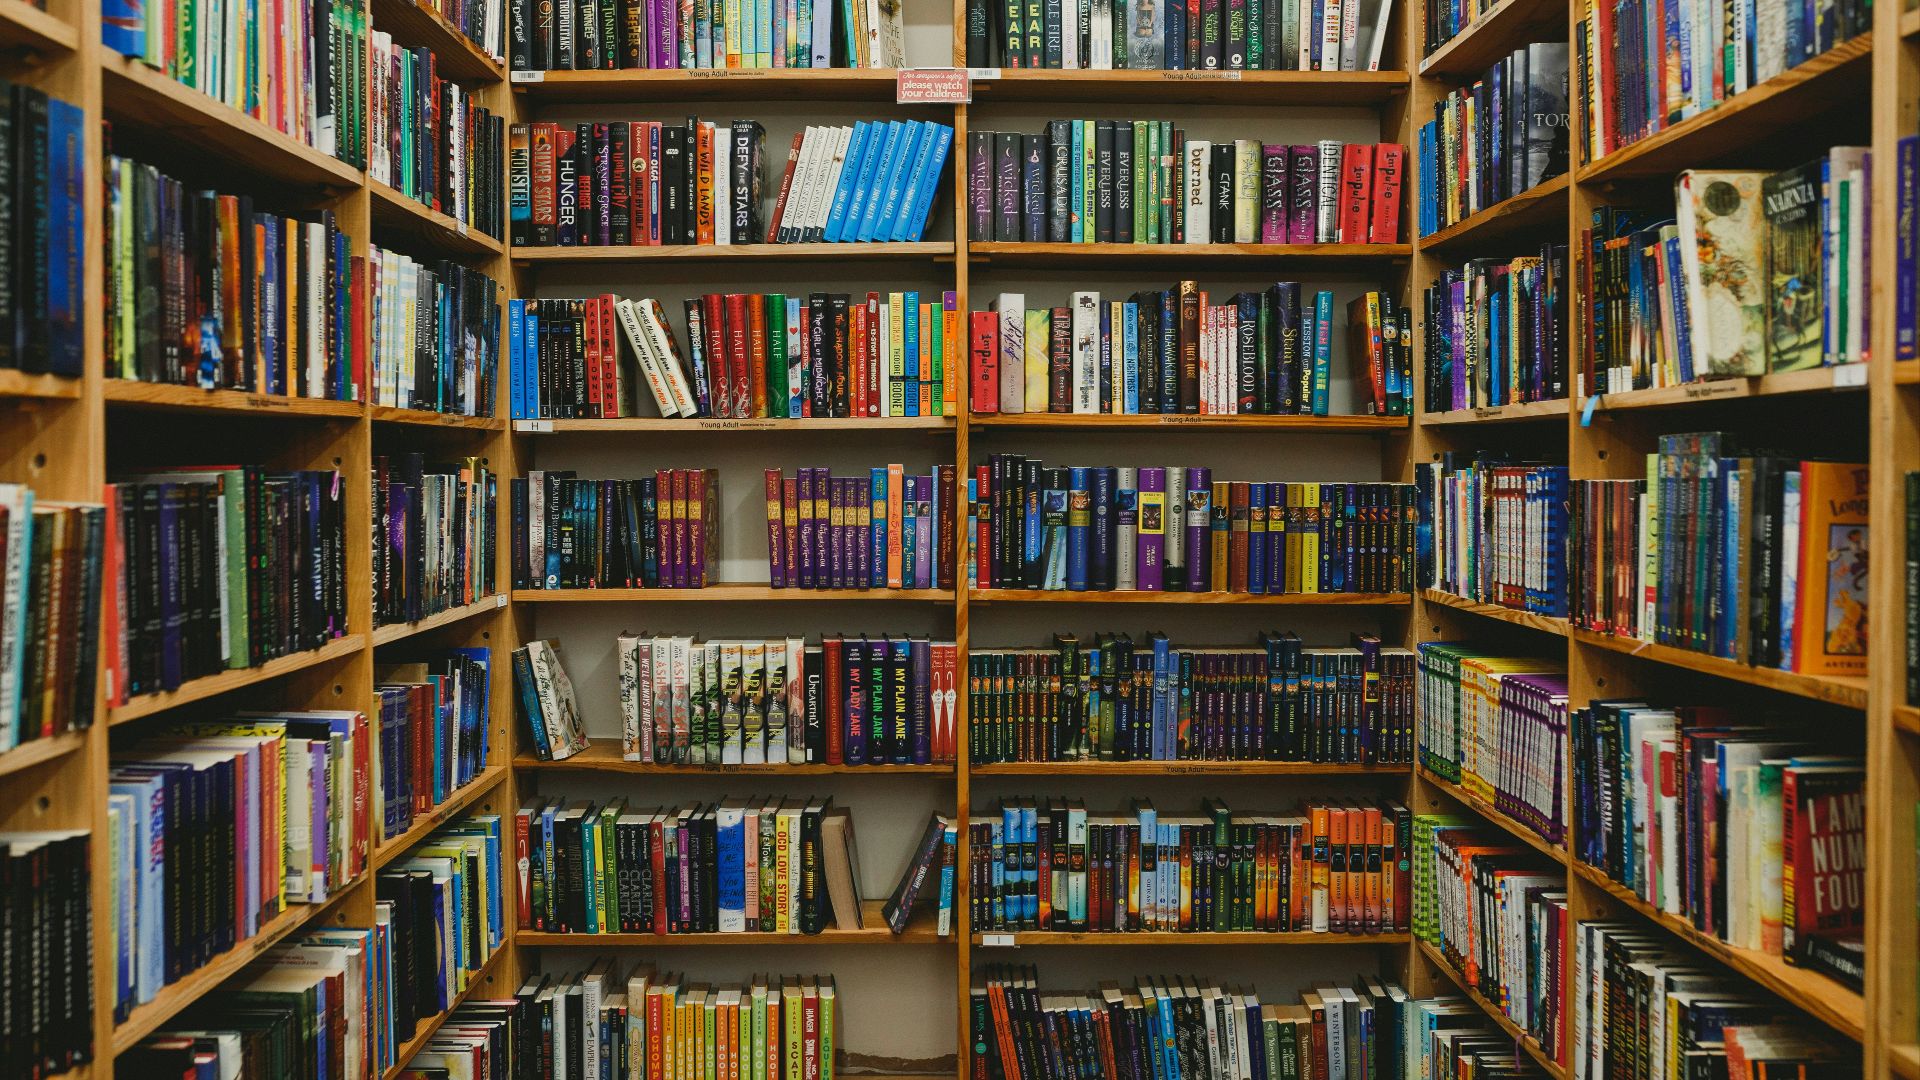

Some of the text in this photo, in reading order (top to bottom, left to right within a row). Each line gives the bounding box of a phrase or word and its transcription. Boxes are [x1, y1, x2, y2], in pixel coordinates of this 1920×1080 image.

[627, 7, 641, 46] DEEPER
[977, 8, 986, 37] GREAT
[1047, 24, 1060, 55] FIRE
[901, 89, 965, 99] your children.
[903, 80, 963, 90] please watch
[1162, 72, 1183, 80] Young
[512, 127, 526, 135] GRANT
[1533, 113, 1569, 129] TOR
[511, 149, 529, 209] MONSTER
[534, 143, 551, 222] SILVER STARS
[597, 145, 609, 227] STRANGE GRACE
[650, 159, 658, 181] OLGA
[700, 152, 709, 184] WILD
[736, 137, 748, 227] DEFY STARS
[976, 160, 991, 213] wicked
[1003, 162, 1018, 214] wicked
[1056, 146, 1069, 216] CRUSADE
[1087, 163, 1095, 180] FULL
[1098, 151, 1110, 208] EVERLESS
[1117, 151, 1129, 209] EVERLESS
[1191, 148, 1203, 207] burned
[1266, 156, 1283, 208] GLASS
[1295, 156, 1313, 208] GLASS
[1320, 143, 1338, 210] IDENTICAL
[1347, 166, 1366, 214] impulse
[1378, 152, 1399, 199] impulse
[560, 159, 575, 225] HUNGER
[578, 175, 591, 210] REFUGEE
[610, 185, 628, 208] City
[635, 177, 643, 230] WOLF BY WOLF
[699, 189, 709, 226] LANDS
[1219, 172, 1230, 210] CRANK
[711, 330, 722, 359] HALF
[734, 330, 744, 359] HALF
[752, 330, 761, 360] HALF
[1053, 314, 1071, 373] TRAFFICK
[1282, 327, 1297, 365] Stain
[1303, 318, 1311, 357] MISSION
[1316, 320, 1329, 390] FISH TREE
[813, 326, 826, 400] GIRL MIDNIGHT
[833, 327, 844, 396] SHADOW HOUR
[1112, 358, 1121, 403] RAVEN'S GATE
[1127, 358, 1135, 394] NIGHTRISE
[1164, 328, 1176, 396] REAWAKENED
[604, 363, 613, 410] TOWNS
[892, 382, 903, 408] BOONE
[907, 382, 916, 408] BOONE
[531, 422, 539, 430] H
[531, 478, 544, 559] DEARLY, DEPARTED
[550, 475, 560, 549] DEARLY, BELOVED
[656, 660, 669, 699] ASHES
[673, 660, 687, 699] ASHES
[692, 664, 704, 699] BURN
[809, 674, 819, 728] UNEARTHLY
[641, 658, 651, 752] WE'LL ALWAYS HAVE Summer
[850, 668, 860, 738] MY LADY JANE
[872, 668, 883, 739] MY PLAIN JANE
[895, 668, 906, 740] MY PLAIN JANE
[623, 733, 635, 754] before
[1807, 797, 1816, 835] I
[1828, 793, 1864, 833] AM
[545, 841, 553, 873] MICROSAURS
[777, 831, 787, 916] OCD LOVE STORY
[1811, 833, 1864, 874] NUM
[597, 879, 605, 911] MINUTES
[618, 868, 629, 918] CLARITY
[629, 868, 641, 918] CLARITY
[1813, 873, 1860, 914] FOU
[651, 1034, 660, 1080] CHOMP
[1267, 1037, 1277, 1075] MOSSFLOWER
[1332, 1012, 1344, 1072] WINTERSONG
